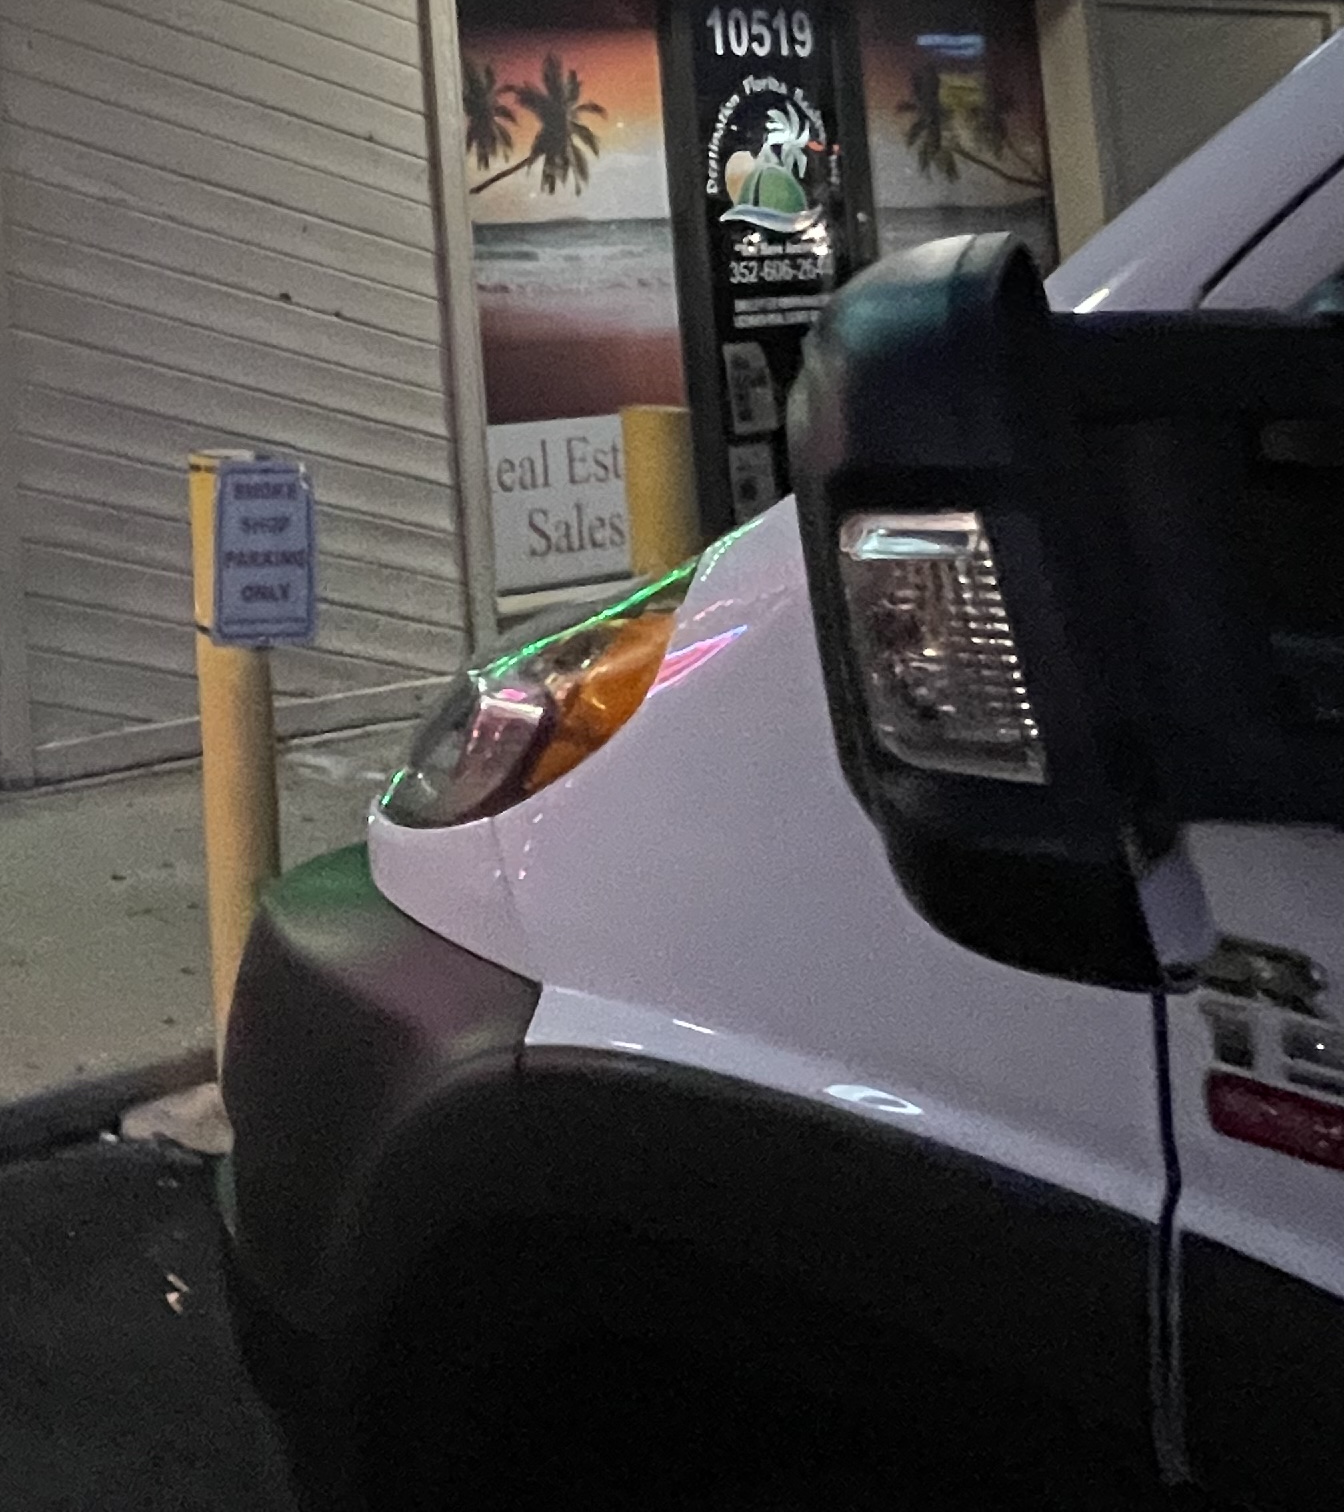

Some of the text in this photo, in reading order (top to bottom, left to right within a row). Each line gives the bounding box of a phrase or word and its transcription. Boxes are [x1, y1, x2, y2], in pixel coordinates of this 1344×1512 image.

[706, 5, 814, 58] 10519
[492, 436, 623, 494] eal Est
[528, 502, 627, 558] Sales
[223, 548, 309, 570] PARKING
[240, 583, 291, 604] ONLY
